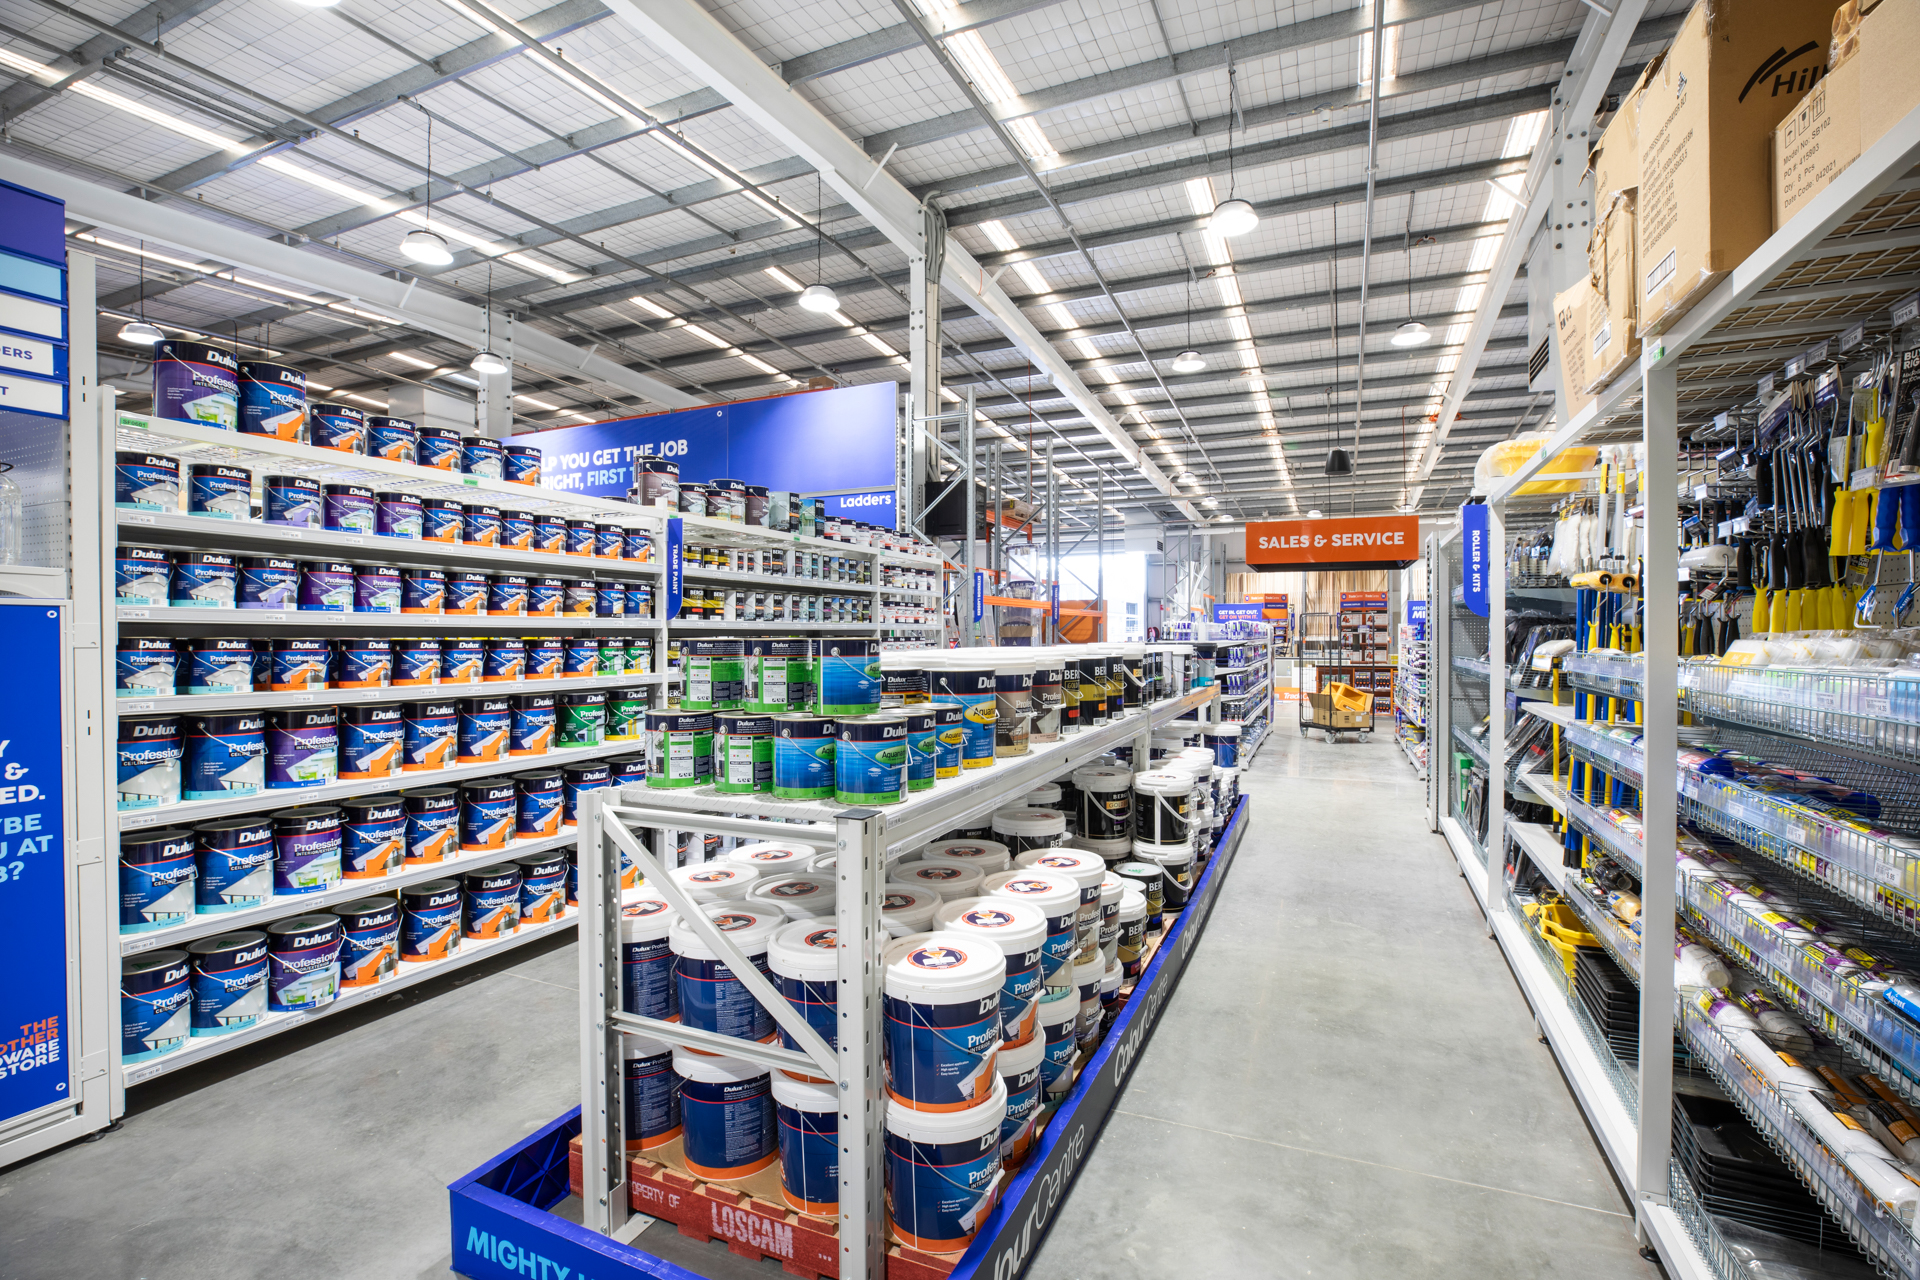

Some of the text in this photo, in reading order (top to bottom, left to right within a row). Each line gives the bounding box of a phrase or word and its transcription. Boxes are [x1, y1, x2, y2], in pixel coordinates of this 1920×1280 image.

[1771, 64, 1828, 97] Hil
[388, 420, 411, 430] Dulux
[479, 439, 499, 449] Dulux
[559, 452, 589, 468] YOU
[592, 448, 621, 466] GET
[624, 444, 653, 460] THE
[660, 438, 688, 457] JOB
[146, 456, 176, 469] Dulux
[217, 468, 247, 479] Dulux
[587, 470, 624, 486] FIRST
[295, 479, 318, 490] Dulux
[349, 487, 372, 498] Dulux
[841, 494, 891, 508] Ladders
[1259, 532, 1404, 549] SALES & SERVICE
[1472, 530, 1480, 563] ROLLER
[132, 550, 164, 560] Dulux
[203, 555, 232, 565] Dulux
[270, 559, 295, 569] Dulux
[331, 564, 353, 573] Dulux
[1473, 564, 1480, 572] &
[380, 568, 399, 576] Dulux
[466, 572, 485, 581] Dulux
[509, 576, 526, 584] Dulux
[139, 640, 171, 649] Dulux
[217, 640, 247, 649] Dulux
[292, 641, 320, 649] Dulux
[369, 641, 389, 649] Dulux
[420, 641, 439, 649] Dulux
[458, 641, 480, 649] Dulux
[484, 701, 508, 710] Dulux
[533, 697, 554, 707] Dulux
[372, 710, 401, 720] Dulux
[427, 706, 455, 716] Dulux
[306, 714, 336, 724] Dulux
[133, 725, 176, 737] Dulux
[4, 762, 29, 780] &
[583, 771, 607, 781] Dulux
[488, 788, 515, 800] Dulux
[425, 798, 455, 810] Dulux
[367, 807, 401, 821] Dulux
[0, 814, 42, 834] BE
[306, 818, 339, 831] Dulux
[239, 830, 272, 843] Dulux
[17, 834, 54, 856] AT
[534, 864, 560, 876] Dulux
[482, 877, 512, 889] Dulux
[429, 892, 458, 907] Dulux
[358, 912, 394, 927] Dulux
[293, 930, 334, 947] Dulux
[235, 945, 267, 964] Dulux
[632, 945, 651, 953] Dulux
[20, 1016, 58, 1036] THE
[633, 1061, 651, 1069] Dulux
[723, 1085, 742, 1093] Dulux
[669, 1194, 680, 1208] OF
[711, 1201, 794, 1259] LOSCAM
[466, 1226, 570, 1280] MIGHTY
